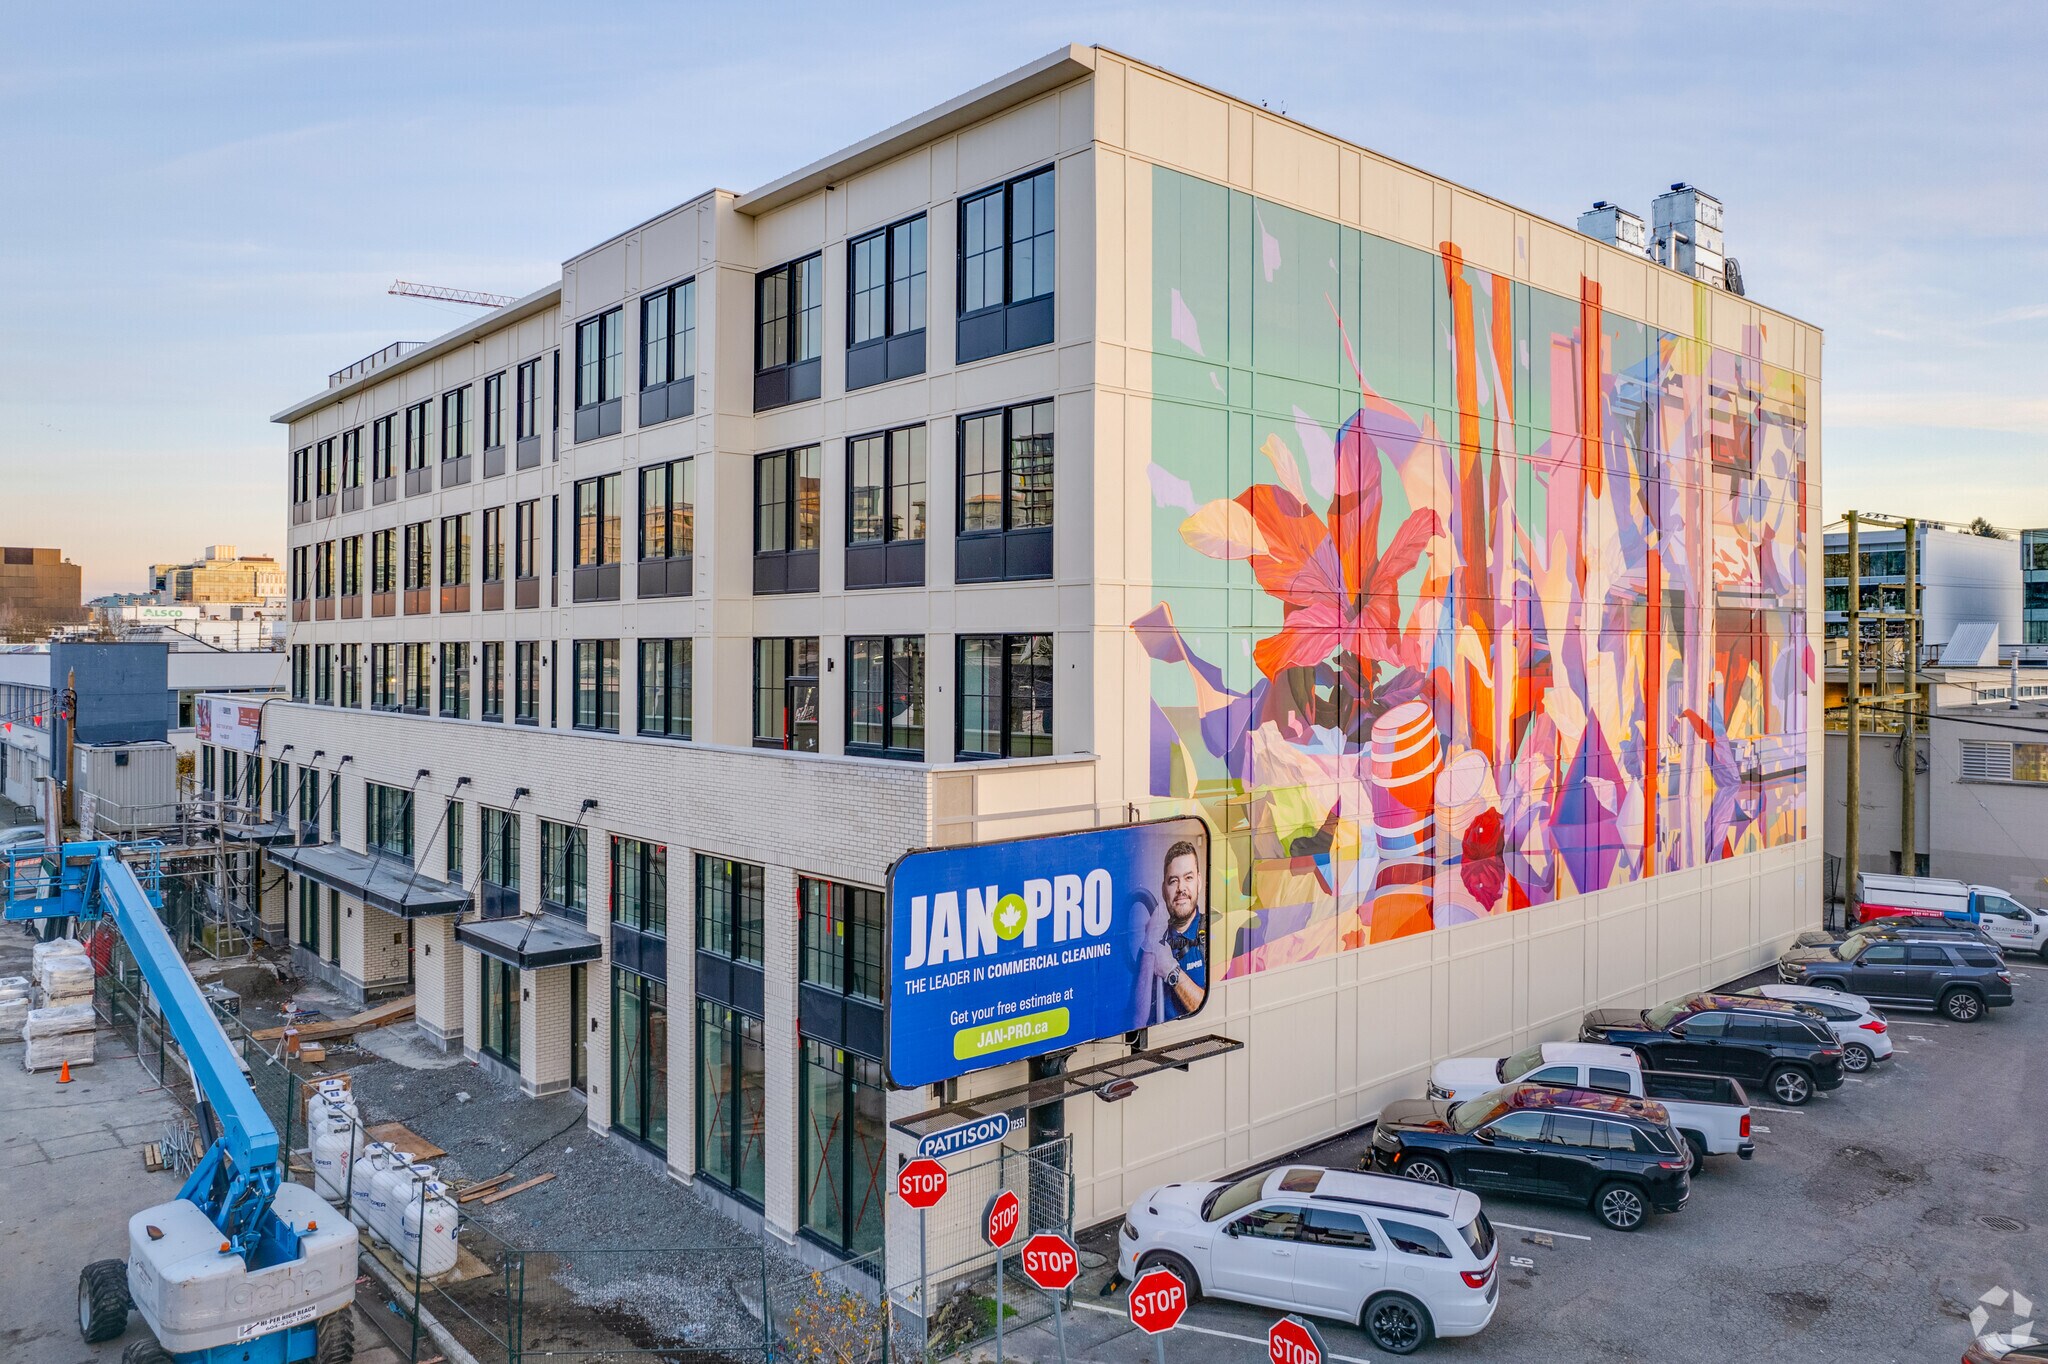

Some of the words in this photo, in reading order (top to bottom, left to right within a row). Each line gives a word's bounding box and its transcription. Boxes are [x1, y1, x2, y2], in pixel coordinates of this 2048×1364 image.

[143, 608, 183, 617] ALSCO
[905, 978, 926, 996] THE
[929, 970, 970, 991] LEADER
[973, 966, 985, 982] IN
[987, 952, 1059, 979] COMMERCIAL
[1062, 942, 1111, 964] CLEANING
[950, 1010, 968, 1026] Get
[972, 1006, 995, 1025] your
[997, 1001, 1017, 1016] free
[1020, 994, 1062, 1011] estimate
[1064, 987, 1074, 1000] at
[977, 1021, 1048, 1049] JAN-PRO.ca
[925, 1119, 1003, 1157] PATTISON
[1010, 1117, 1026, 1131] 12551
[901, 1173, 945, 1194] STOP
[991, 1203, 1017, 1236] STOP
[1027, 1251, 1073, 1273] STOP
[1510, 1255, 1534, 1269] 15
[1134, 1286, 1182, 1318] STOP
[1272, 1334, 1317, 1364] STOP
